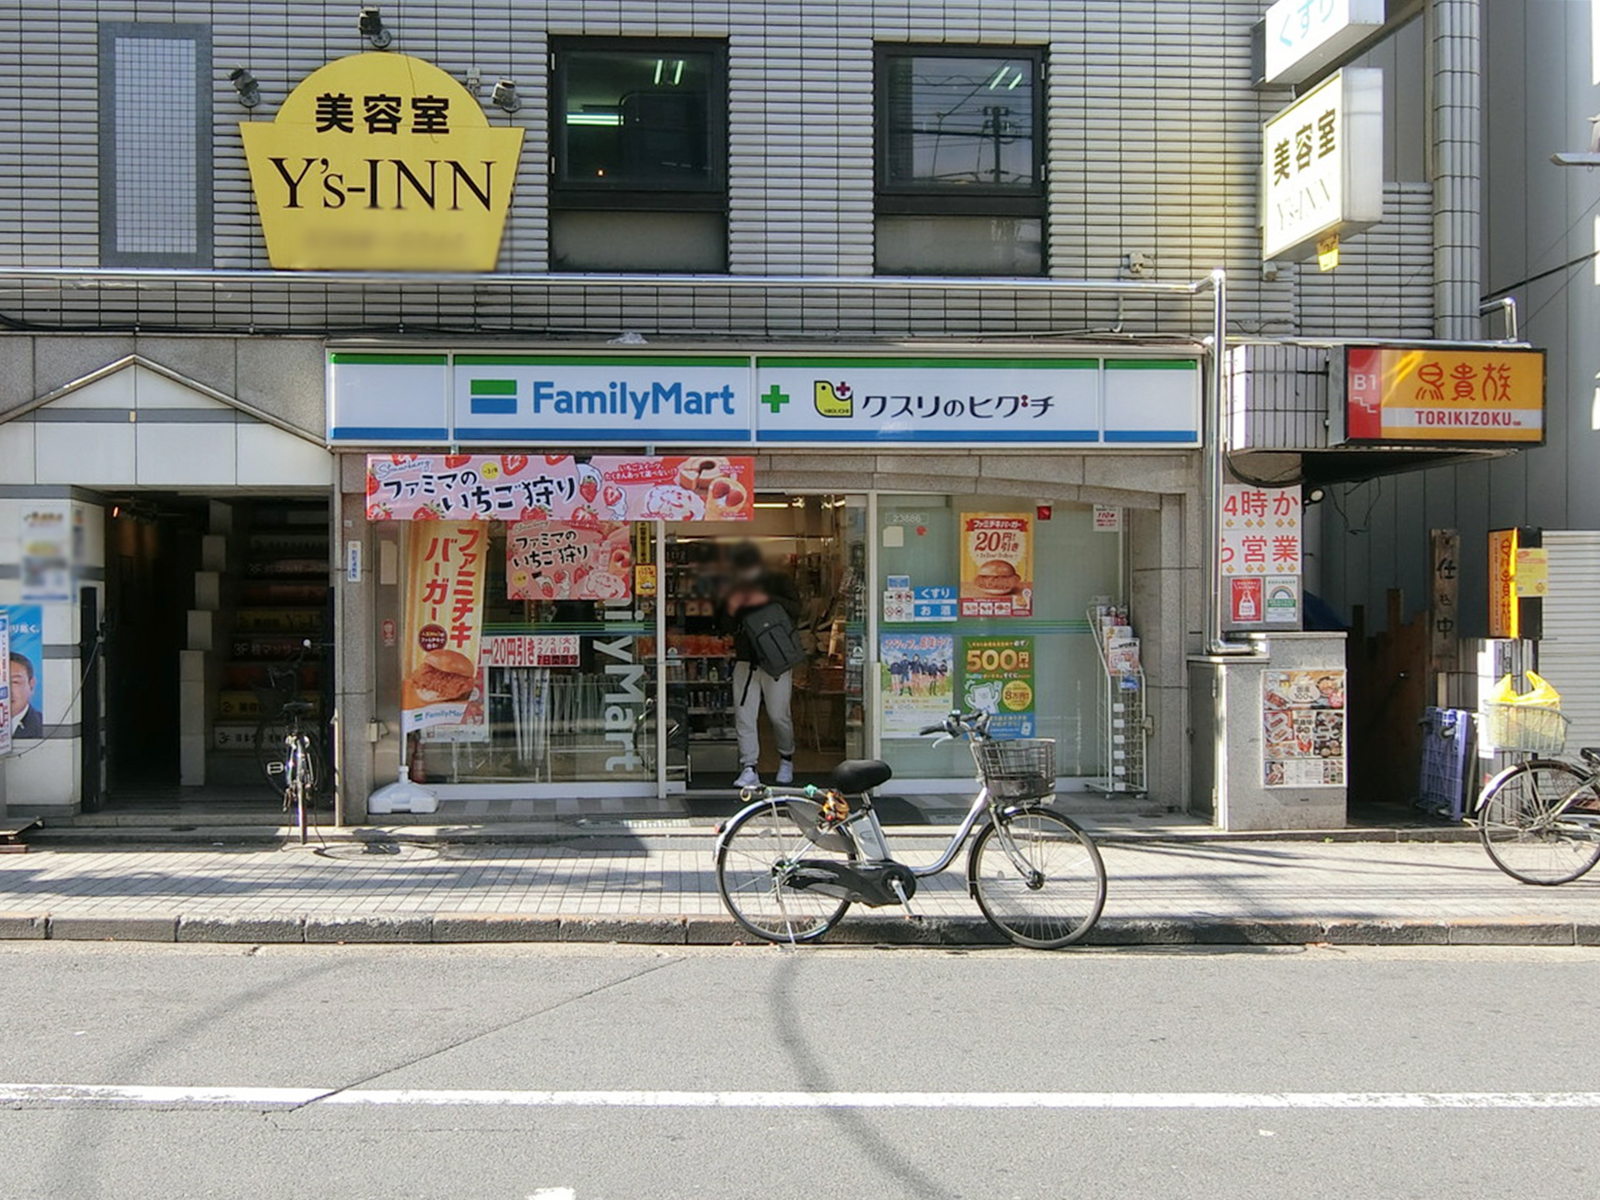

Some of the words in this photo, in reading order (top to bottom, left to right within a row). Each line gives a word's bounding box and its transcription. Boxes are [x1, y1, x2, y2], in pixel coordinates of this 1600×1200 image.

[316, 93, 450, 135] 美容室
[1274, 108, 1336, 187] 美容室
[268, 157, 497, 211] Y's-INN
[1354, 374, 1377, 391] B1
[1415, 362, 1512, 402] 鳥貴族
[533, 381, 735, 420] FamilyMart
[862, 394, 1055, 418] クスリのヒグチ
[1415, 411, 1513, 426] TORIKIZOKU
[384, 471, 478, 499] ファミマの
[441, 475, 576, 513] いちご狩り
[1223, 489, 1299, 518] 4時か
[515, 530, 577, 549] ファミマの
[975, 531, 1001, 552] 20
[513, 543, 589, 568] いちご狩り
[422, 537, 458, 621] バーガー
[450, 528, 480, 649] ファミチキ
[921, 587, 951, 599] くすり
